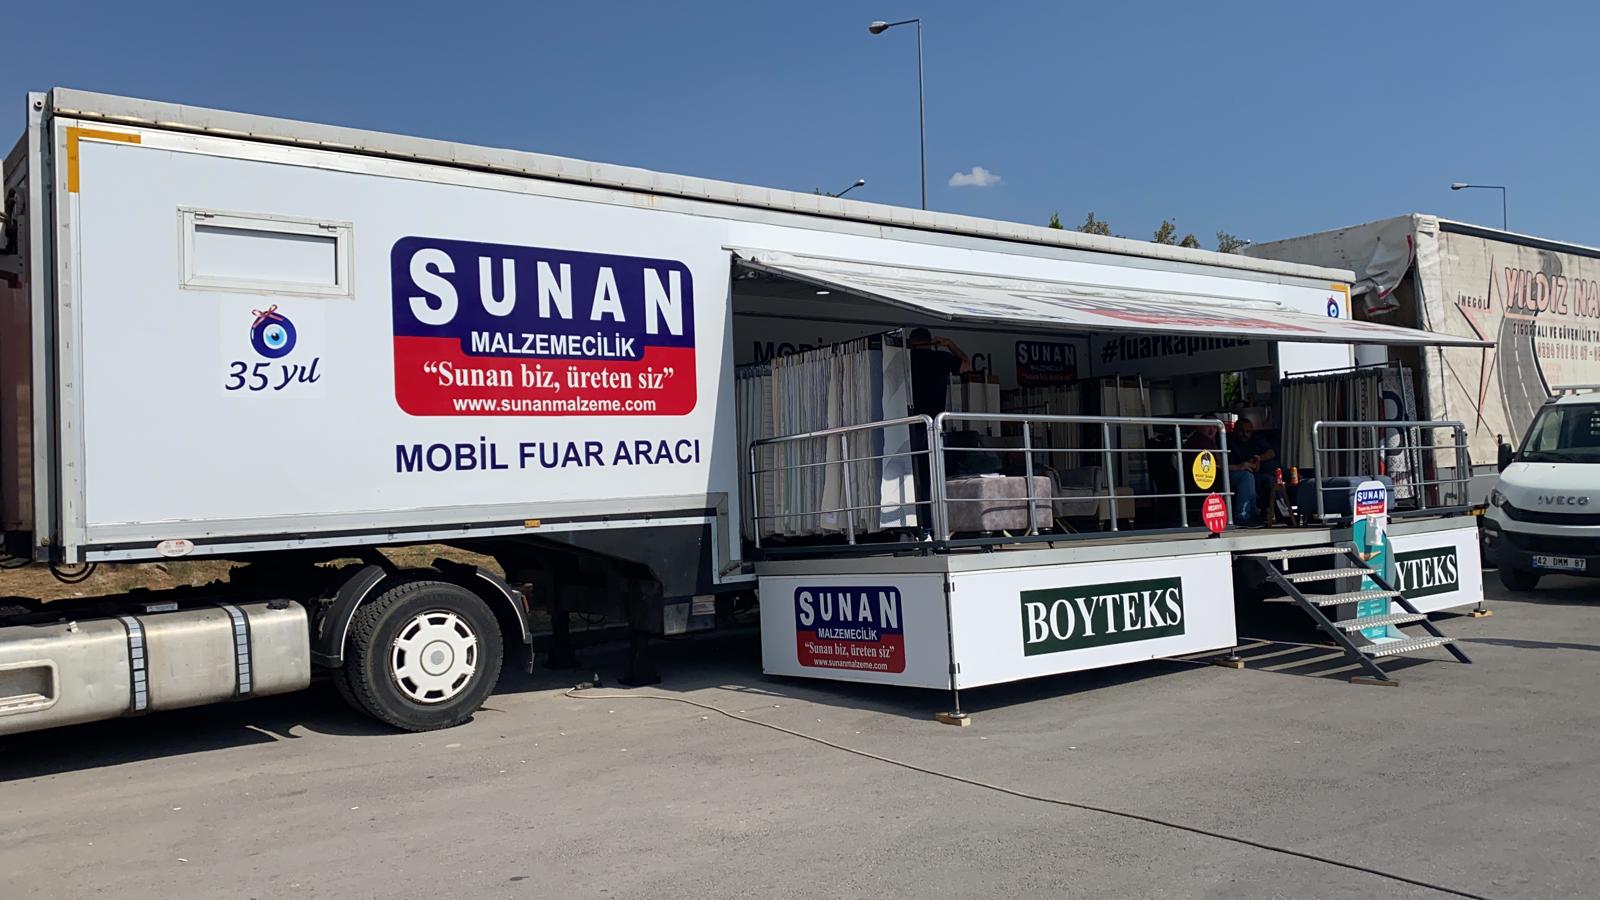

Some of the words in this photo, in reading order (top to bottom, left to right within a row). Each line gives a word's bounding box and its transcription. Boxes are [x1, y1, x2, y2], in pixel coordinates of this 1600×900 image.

[408, 247, 683, 336] SUNAN
[1504, 266, 1568, 315] YILDIZ
[471, 331, 636, 358] MALZEMECİLİK
[1549, 325, 1557, 339] VE
[1017, 342, 1075, 367] SUNAN
[225, 361, 271, 391] 35
[273, 357, 320, 391] yıl
[423, 360, 513, 387] “Sunan
[521, 363, 560, 393] biz,
[567, 365, 632, 389] üreten
[638, 367, 674, 389] siz”
[453, 396, 656, 412] www.sunanmalzeme.com
[395, 436, 509, 473] MOBİL
[519, 441, 604, 469] FUAR
[613, 439, 701, 466] ARACI
[1357, 490, 1384, 502] SUNAN
[1537, 495, 1590, 506] IVECO
[1537, 556, 1547, 565] 42
[799, 591, 898, 629] SUNAN
[1024, 587, 1182, 644] BOYTEKS
[818, 627, 878, 641] MALZEMECİLİK
[834, 643, 849, 658] biz,
[851, 644, 877, 658] üreten
[814, 658, 888, 670] www.sunanmalzeme.com
